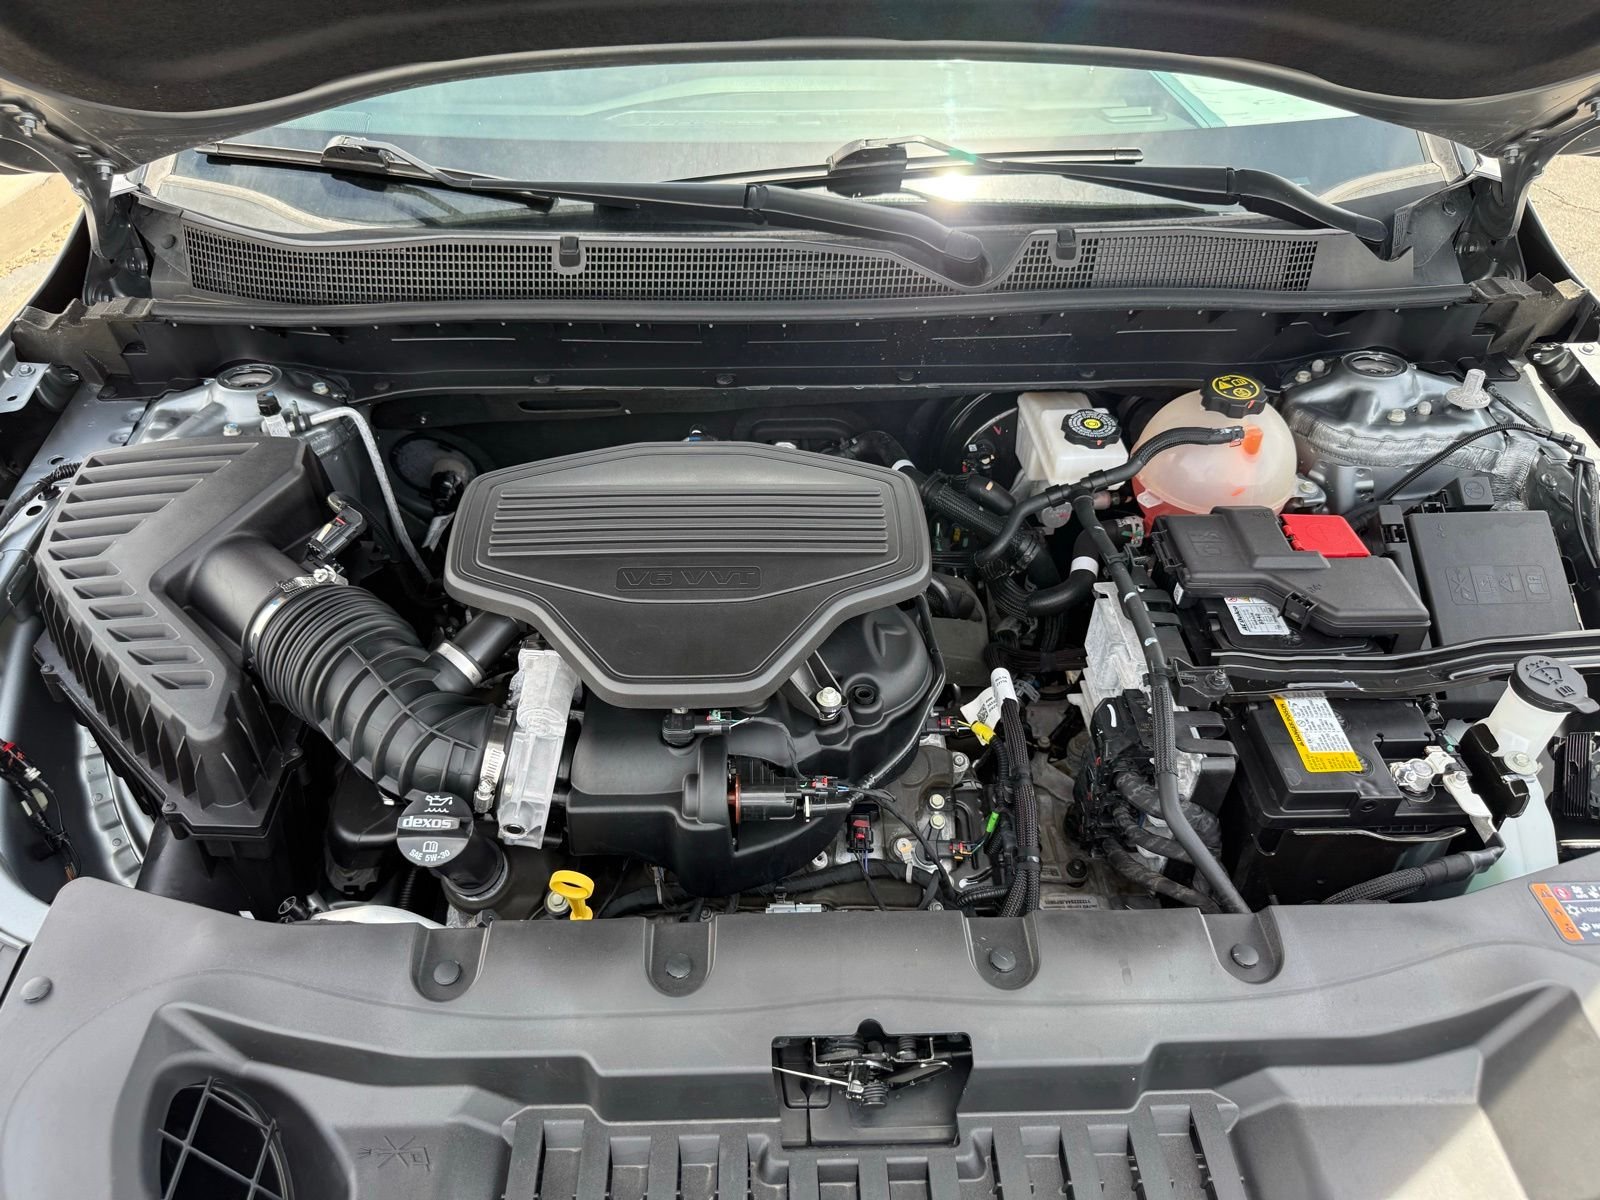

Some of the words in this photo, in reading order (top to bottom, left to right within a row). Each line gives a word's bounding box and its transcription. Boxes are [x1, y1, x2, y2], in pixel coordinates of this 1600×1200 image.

[622, 571, 673, 586] V6
[681, 570, 755, 585] VVT
[402, 816, 453, 828] dexos
[409, 848, 423, 860] SAE
[424, 849, 451, 862] 5W-30
